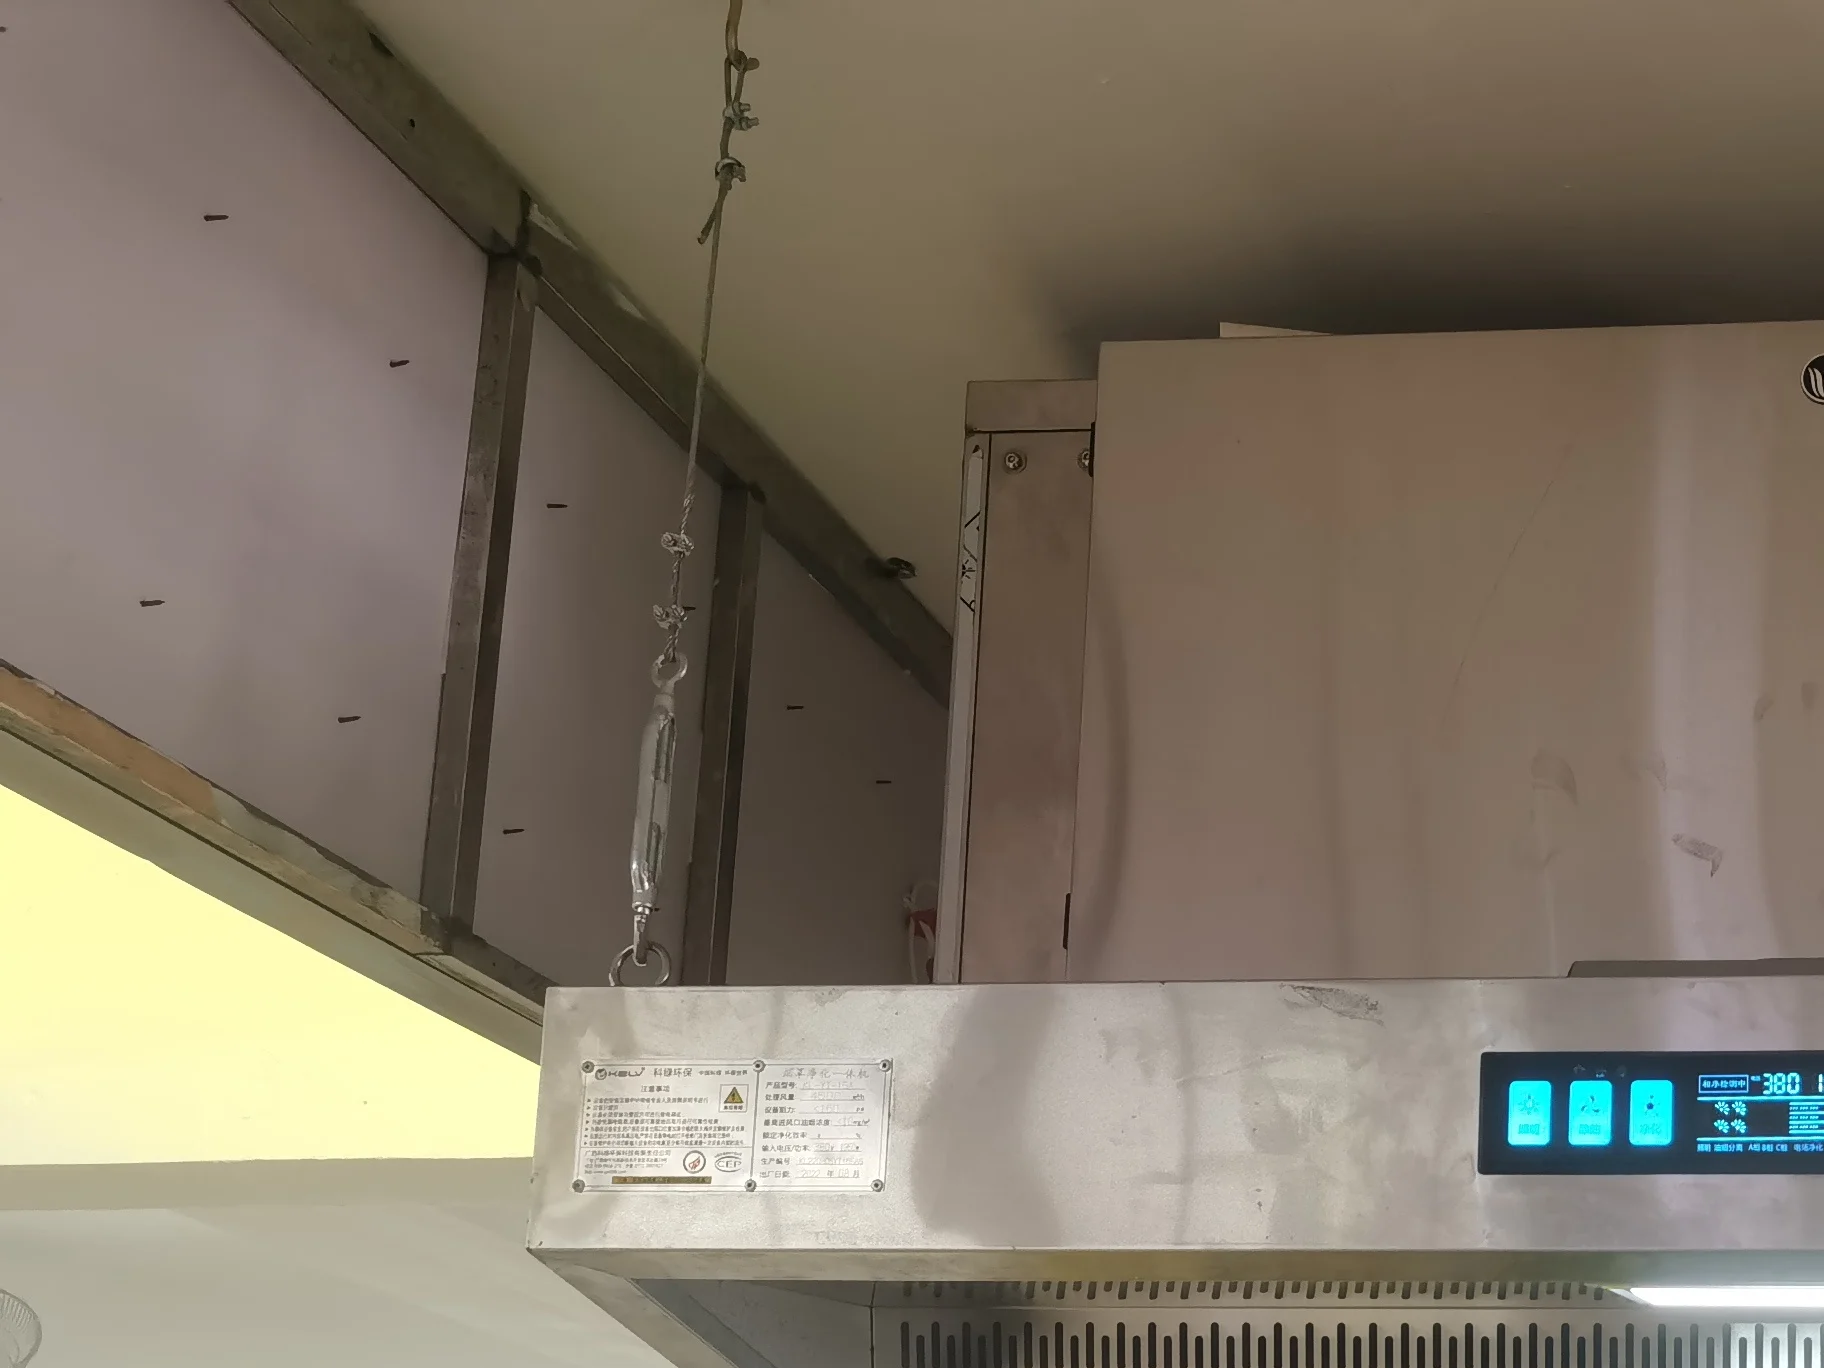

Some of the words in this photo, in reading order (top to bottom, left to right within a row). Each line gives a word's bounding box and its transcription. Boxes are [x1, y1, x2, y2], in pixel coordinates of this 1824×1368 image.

[653, 1067, 693, 1078] 科绿环保
[1762, 1073, 1800, 1095] 380
